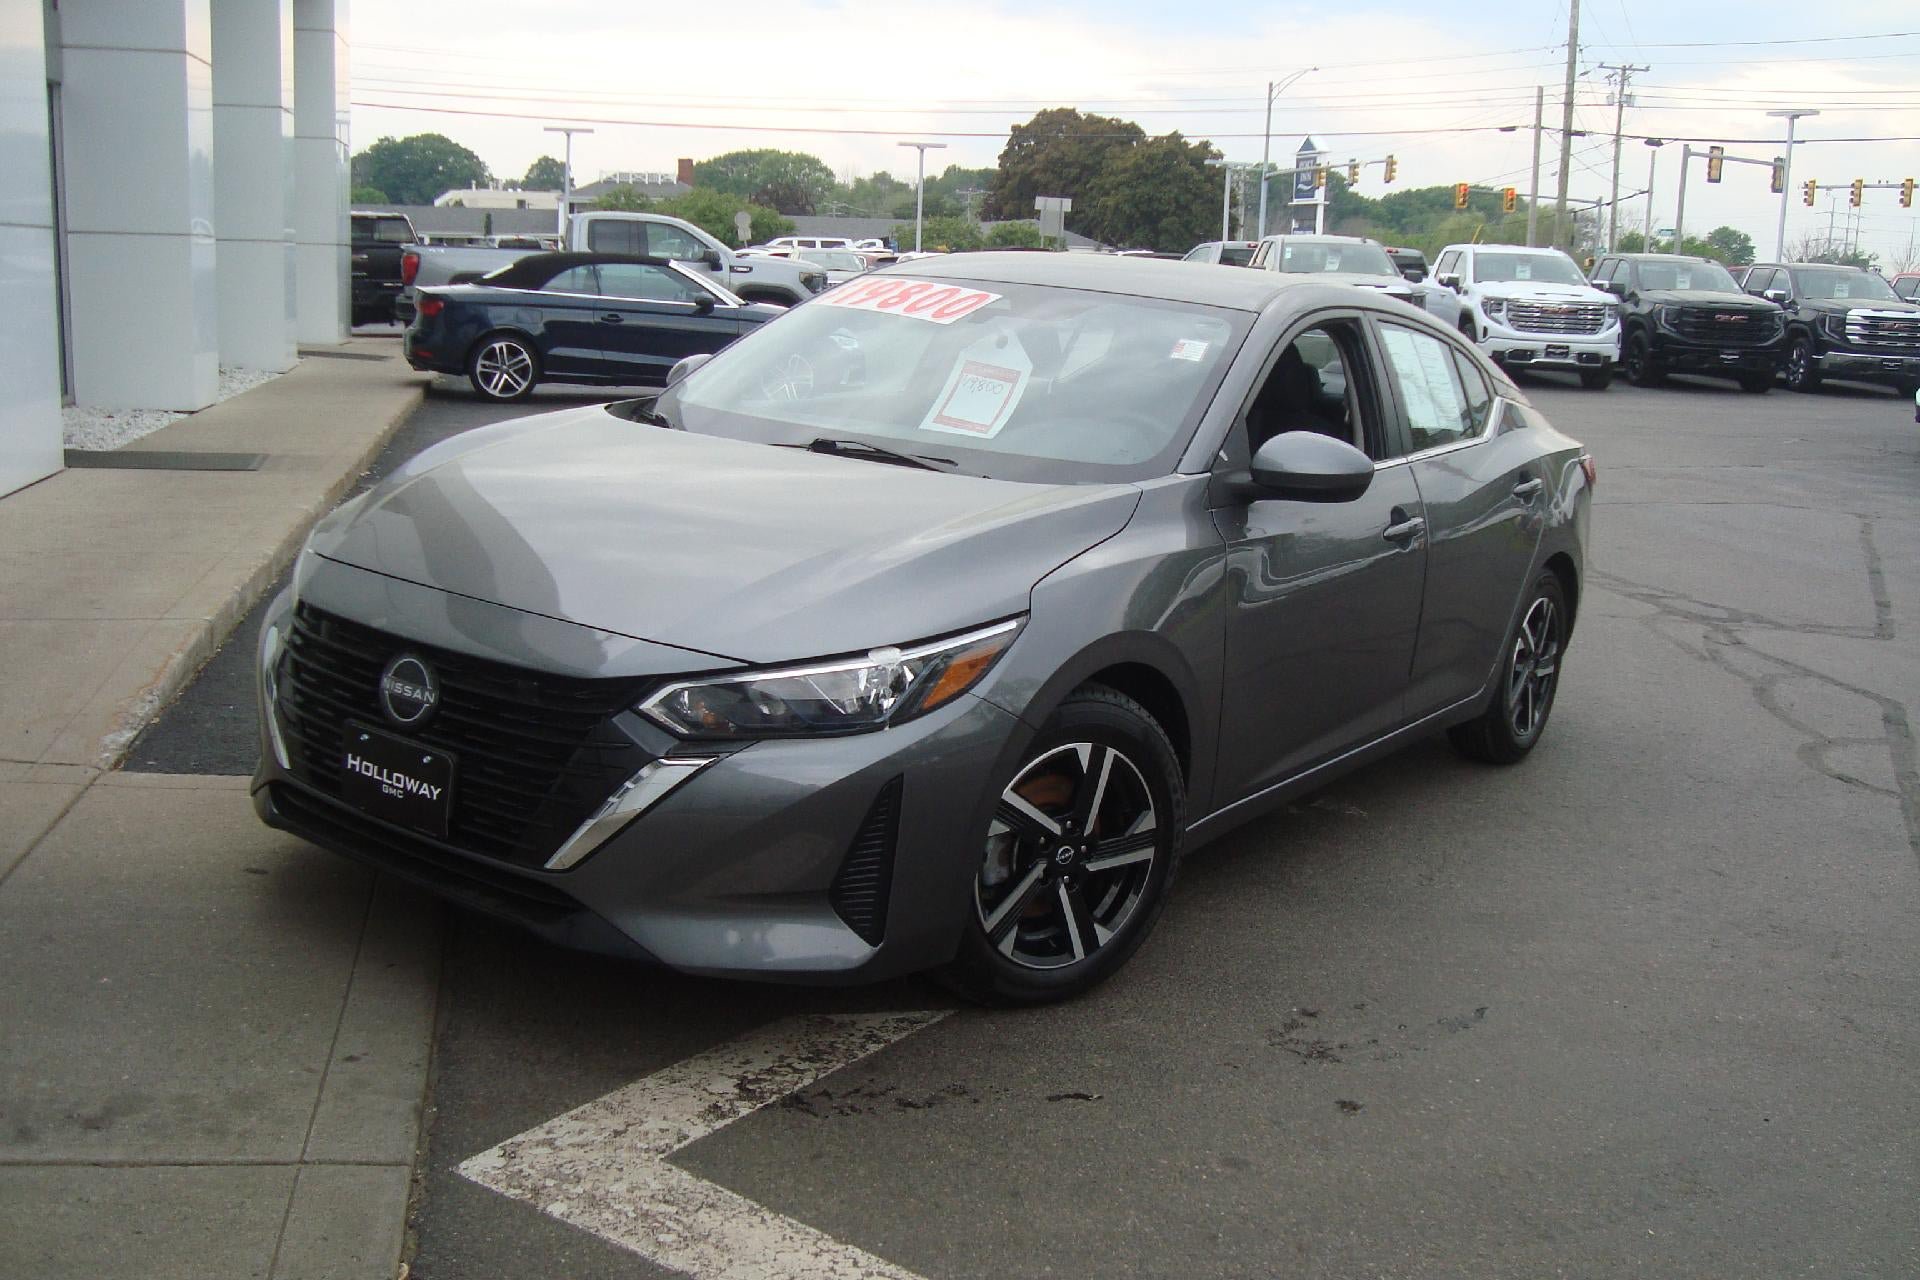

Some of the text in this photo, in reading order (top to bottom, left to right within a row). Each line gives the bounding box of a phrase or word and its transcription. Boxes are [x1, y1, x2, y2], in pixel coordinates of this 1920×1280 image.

[384, 675, 435, 704] NISSAN
[346, 753, 442, 801] HOLLOWAY
[382, 784, 404, 799] GMC
